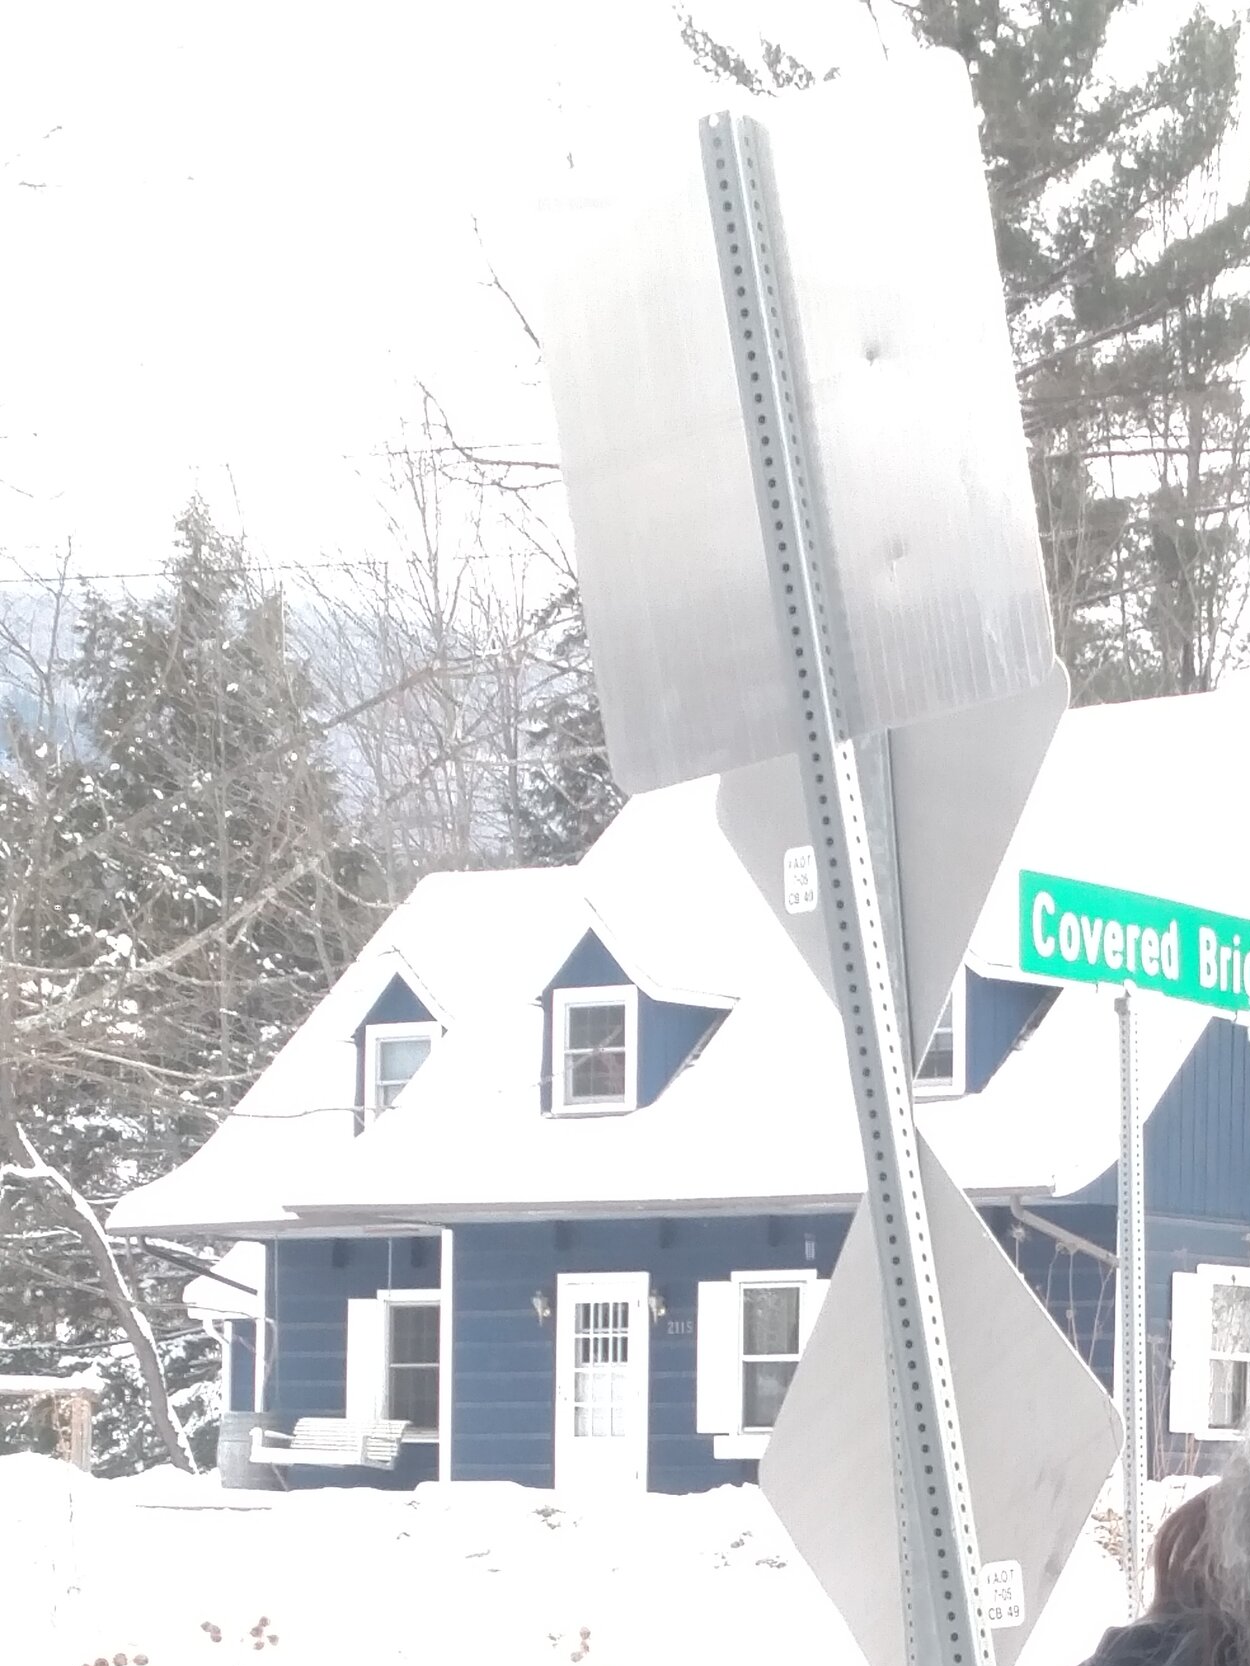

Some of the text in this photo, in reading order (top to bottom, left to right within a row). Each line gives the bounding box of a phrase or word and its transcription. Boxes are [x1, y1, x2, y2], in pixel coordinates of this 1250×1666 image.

[1032, 891, 1180, 981] Covered
[988, 1604, 1020, 1621] CB 49
